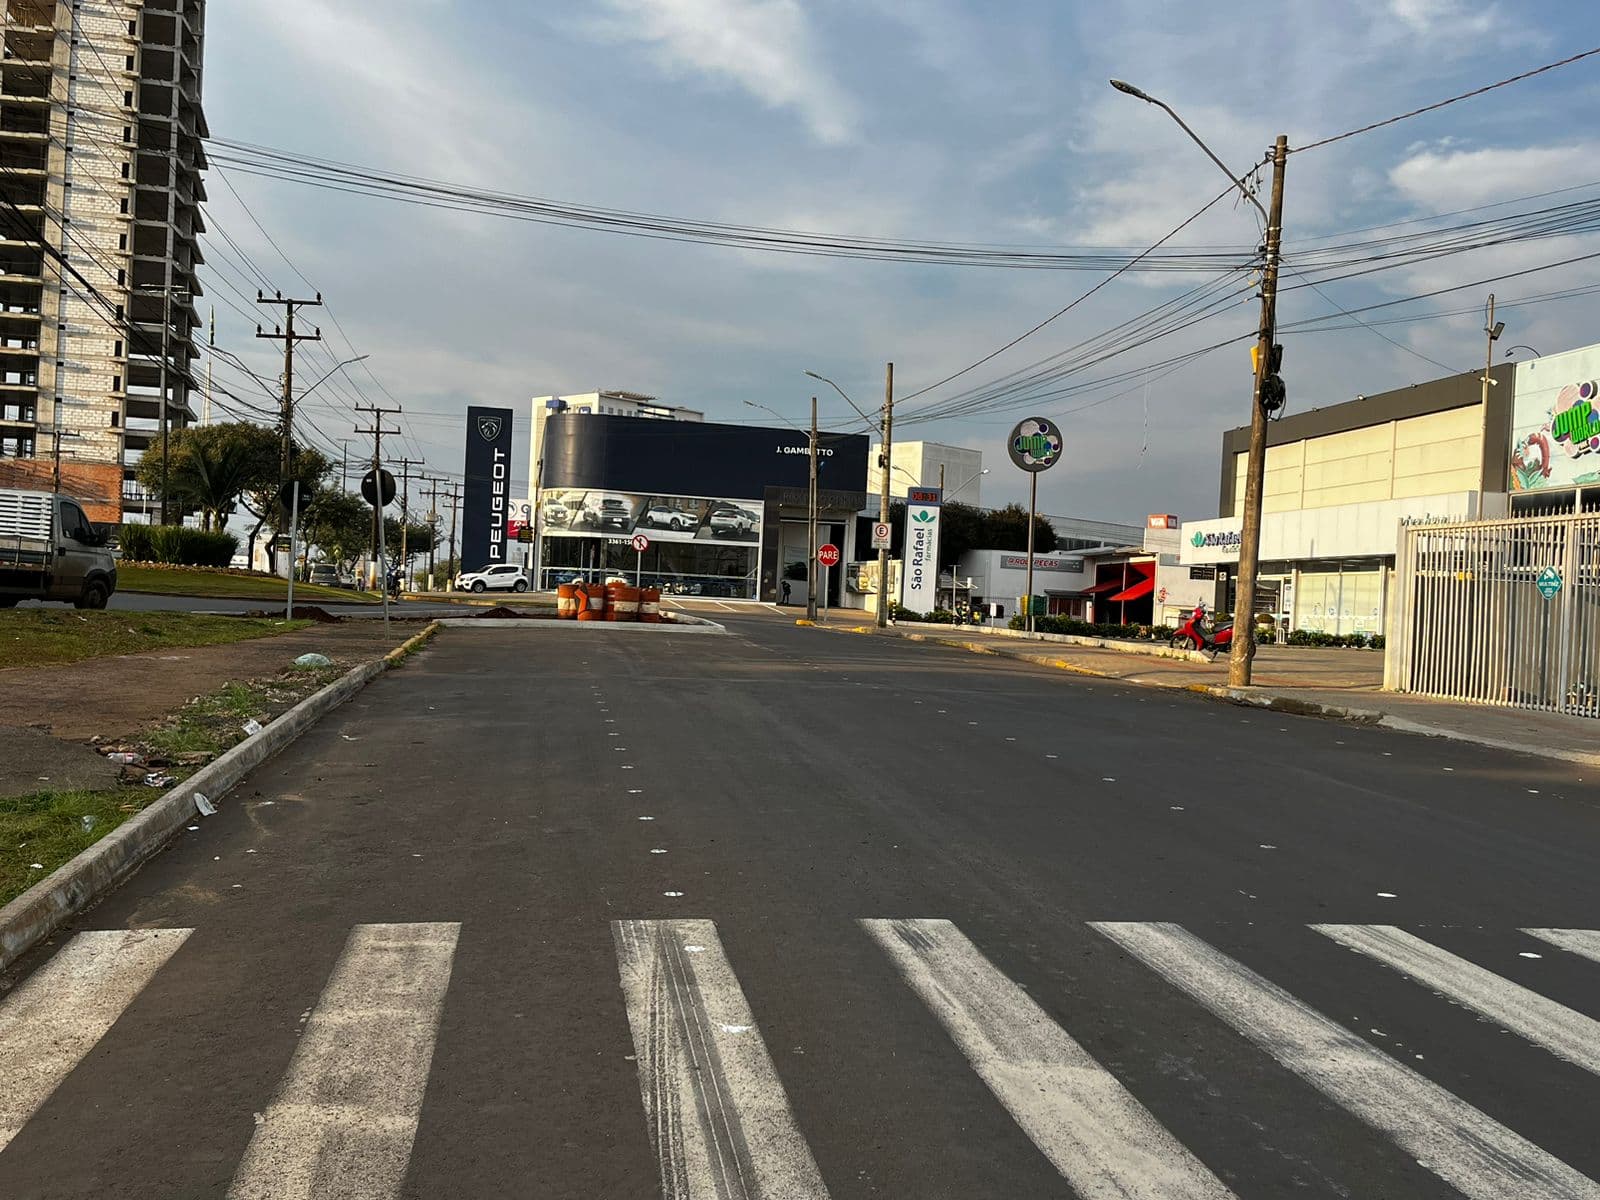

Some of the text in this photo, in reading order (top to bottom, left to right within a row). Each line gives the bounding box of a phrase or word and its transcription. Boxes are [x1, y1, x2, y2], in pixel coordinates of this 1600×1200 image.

[1553, 401, 1593, 439] JUMP
[784, 446, 833, 456] GAMBTTO
[490, 447, 505, 559] PEUGEOT
[819, 550, 837, 560] PARE
[911, 528, 925, 590] São Rafael
